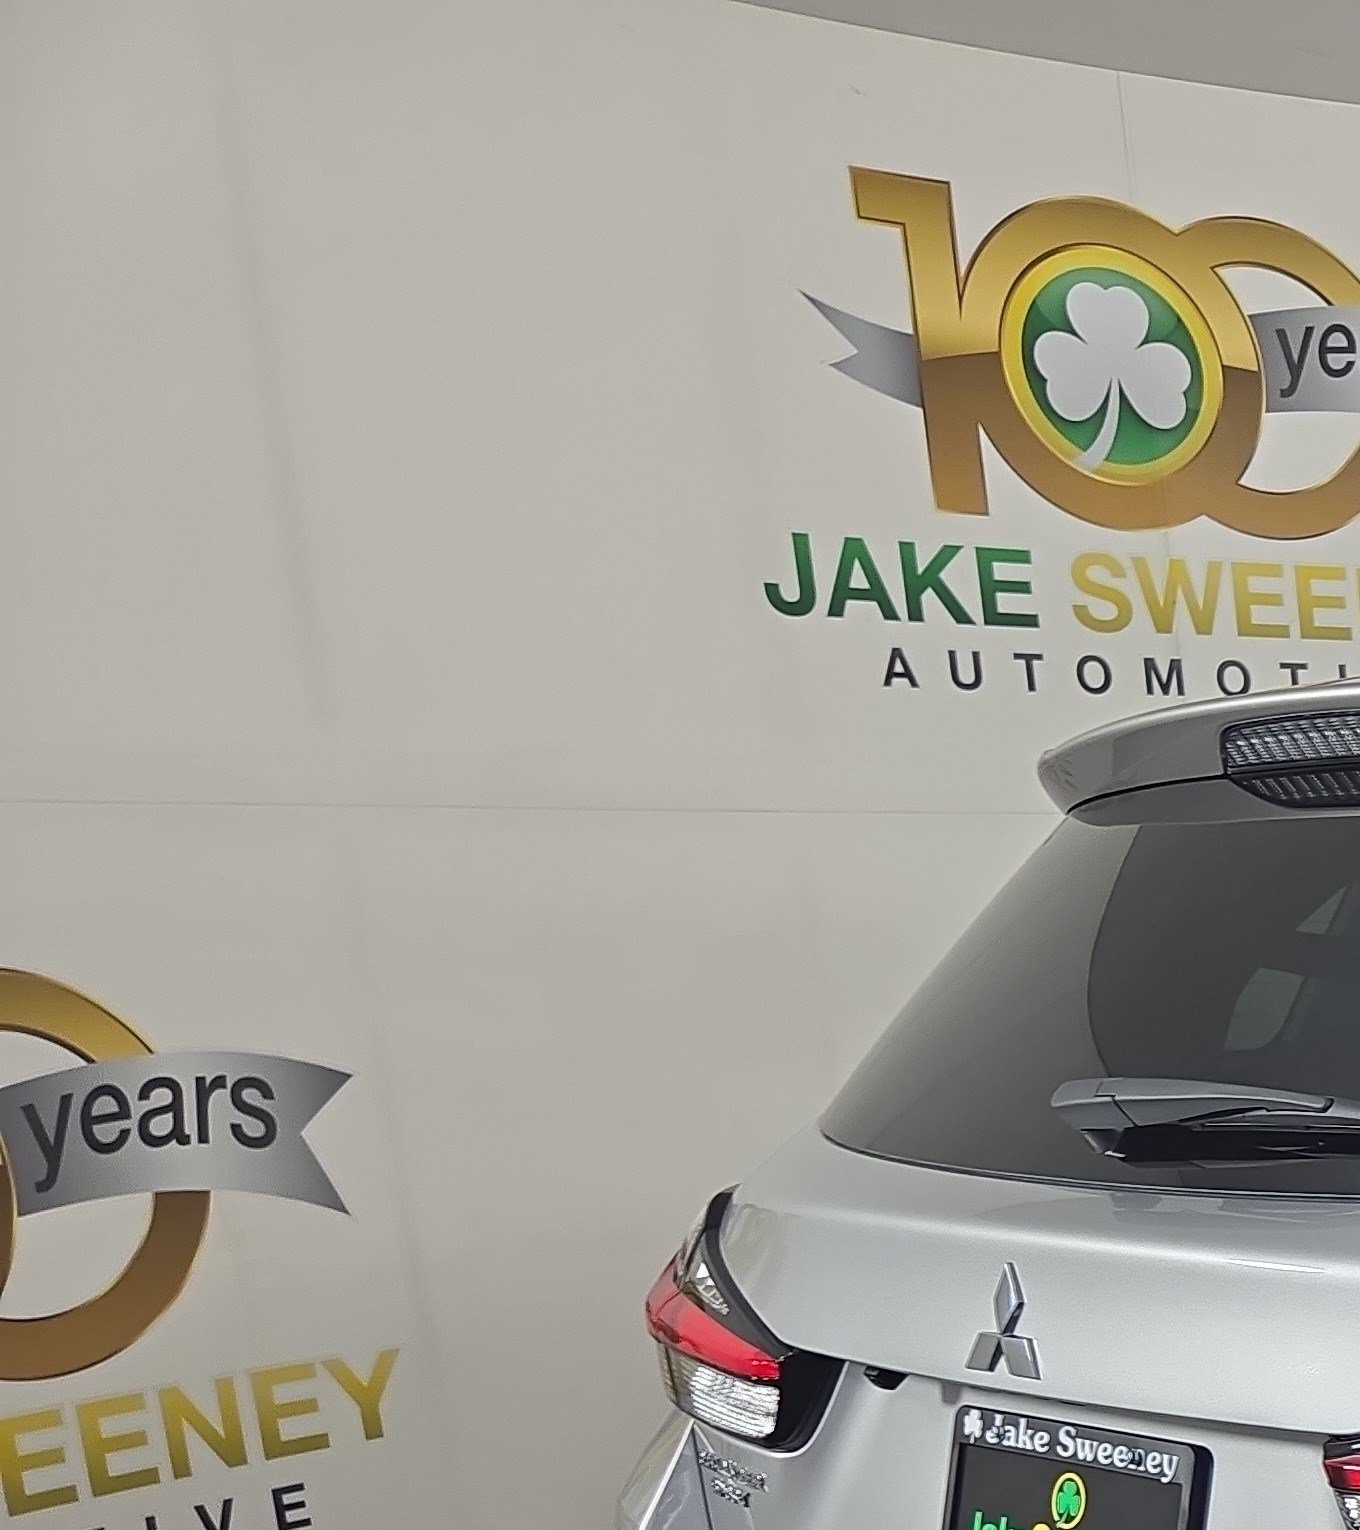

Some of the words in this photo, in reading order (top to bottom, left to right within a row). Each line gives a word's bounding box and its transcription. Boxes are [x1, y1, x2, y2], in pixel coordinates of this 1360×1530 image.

[763, 532, 1041, 629] JAKE
[20, 1072, 278, 1193] years
[1056, 1425, 1179, 1483] Sweeney
